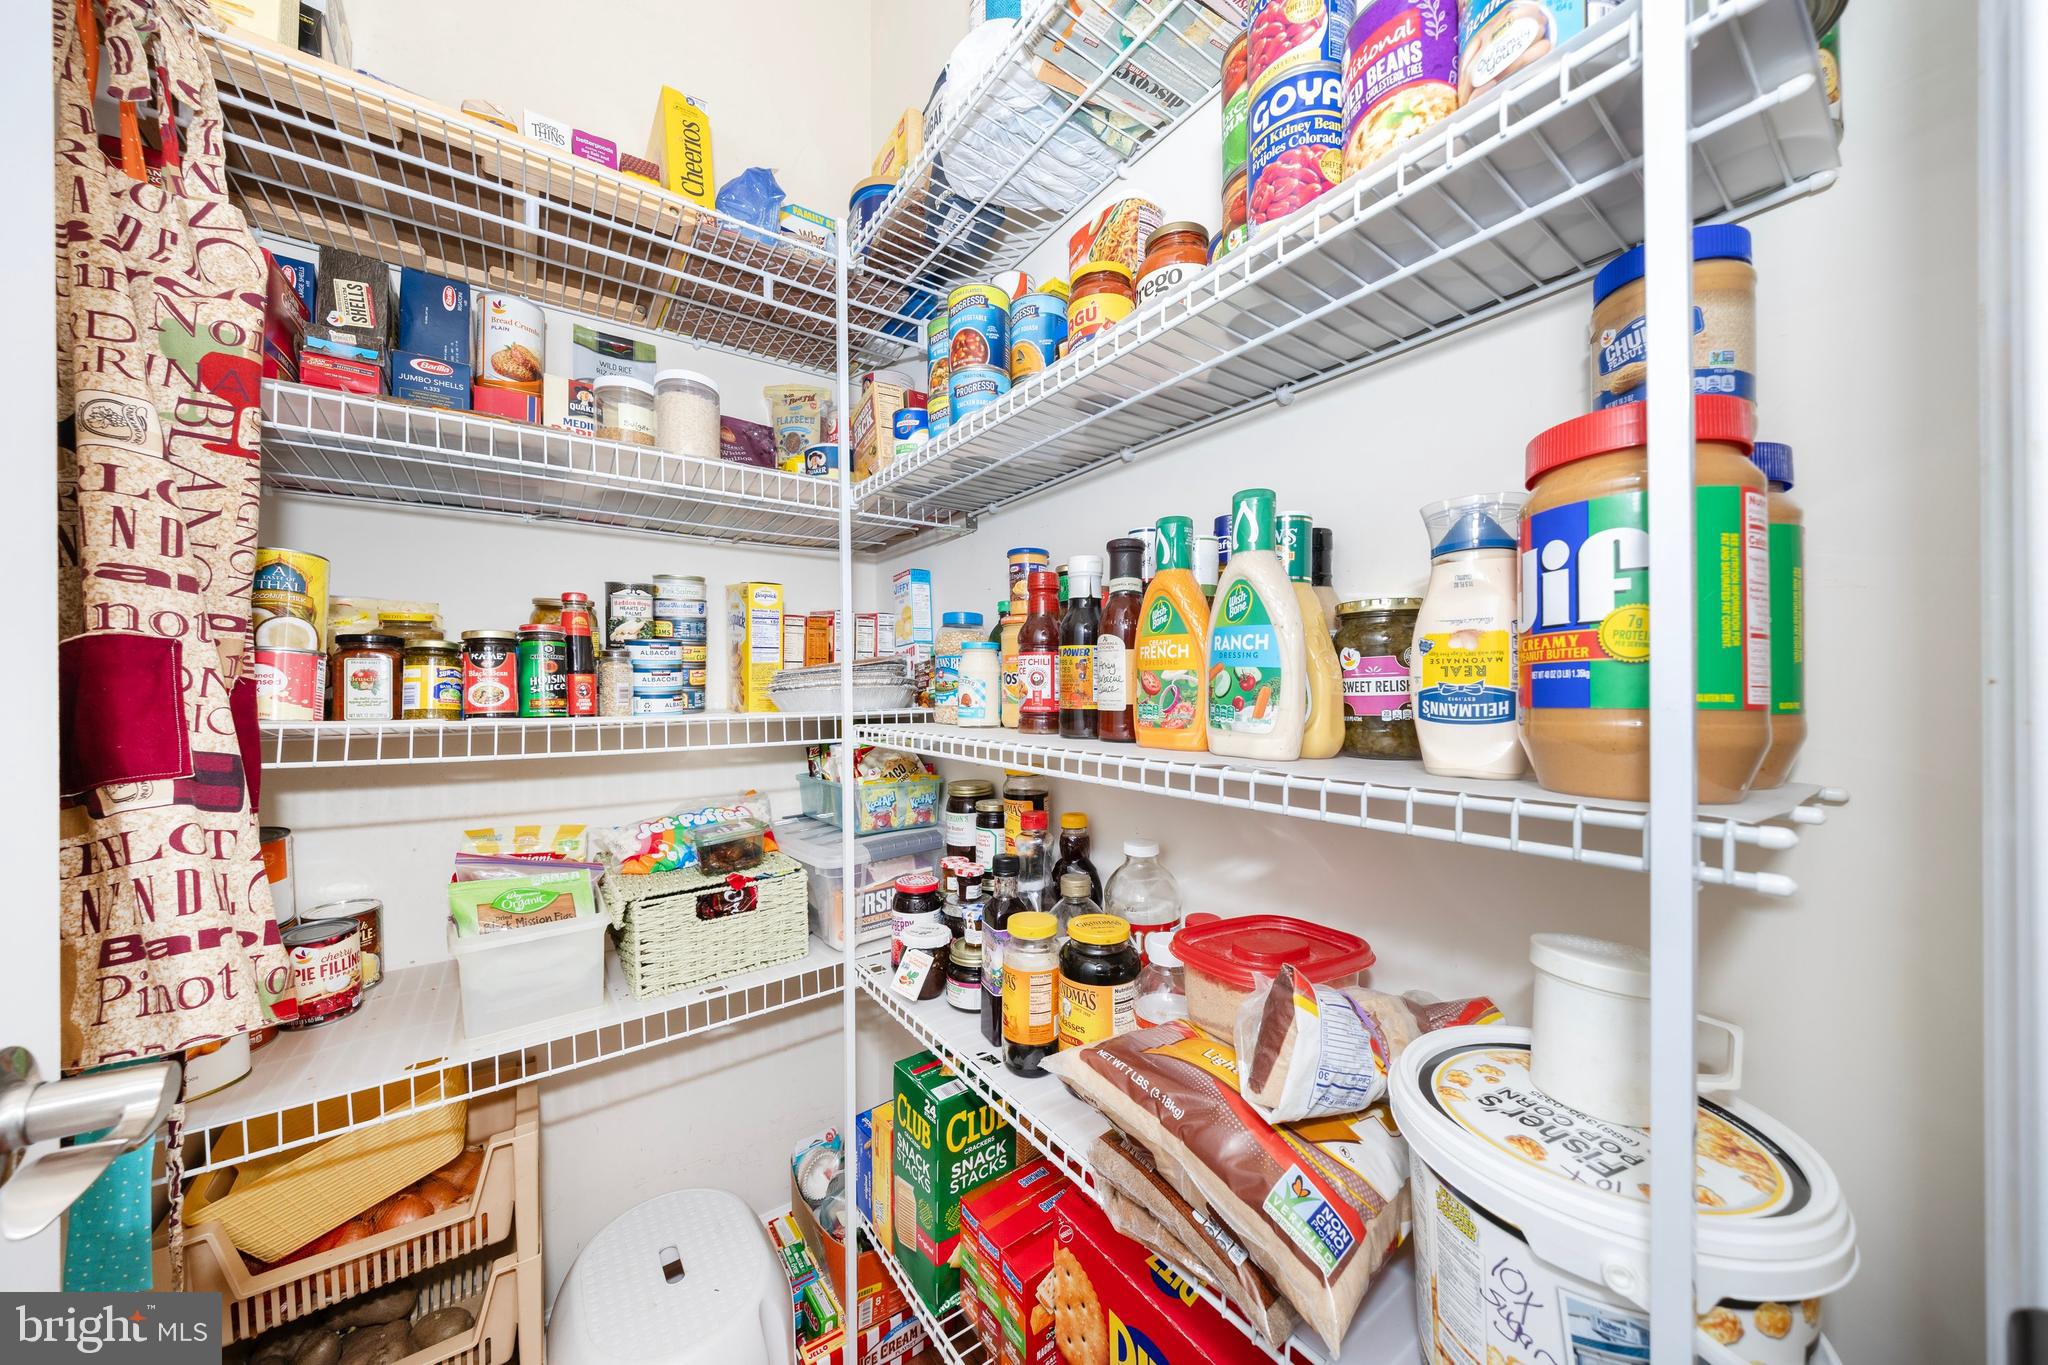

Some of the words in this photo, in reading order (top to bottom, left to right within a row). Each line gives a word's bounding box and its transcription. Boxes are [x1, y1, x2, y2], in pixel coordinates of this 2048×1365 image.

[1365, 40, 1424, 86] BEANS
[1366, 69, 1406, 105] CHOLESTEROL
[1407, 62, 1423, 78] FREE
[1253, 77, 1342, 133] GOYA
[531, 122, 566, 147] THINS
[1252, 141, 1268, 160] Red
[1270, 118, 1311, 143] Kidney
[681, 119, 705, 198] Cheerios
[1252, 142, 1287, 175] Frijoles
[1136, 268, 1183, 307] rego
[347, 283, 368, 324] SHELLS
[950, 295, 986, 317] PROGRESSO
[491, 316, 513, 326] Bread
[1604, 327, 1646, 363] CHU
[419, 359, 450, 374] Barilla
[600, 360, 617, 371] WILD
[618, 363, 633, 374] RICE
[398, 372, 432, 384] JUMBO
[433, 378, 465, 391] SHELLS
[955, 381, 996, 398] PROGRESSO
[855, 416, 874, 444] JACK
[272, 565, 286, 577] A
[1518, 527, 1649, 633] Jif
[257, 579, 303, 592] THAI
[1628, 614, 1643, 630] 7g
[1214, 633, 1270, 651] RANCH
[1522, 634, 1579, 652] CREAMY
[1613, 630, 1649, 640] PROTEI
[1027, 658, 1050, 666] CHILI
[1062, 647, 1091, 657] POWER
[1140, 644, 1190, 659] FRENCH
[1218, 651, 1259, 660] DRESSING
[1430, 656, 1504, 664] MAYONNAISE
[1546, 646, 1589, 660] BUTTER
[1439, 665, 1487, 677] REAL
[1343, 681, 1371, 693] SWEET
[1422, 699, 1510, 719] HELLMANN'S
[867, 791, 896, 812] Kool-Aid
[910, 792, 937, 810] Kool-Aid
[501, 894, 547, 911] Organic
[516, 915, 553, 928] Mission
[321, 948, 353, 964] cherry
[294, 966, 316, 982] PIE
[1096, 1048, 1115, 1065] NET
[1113, 1058, 1128, 1074] WT
[1125, 1066, 1133, 1077] 7
[1131, 1072, 1150, 1093] LBS.
[1150, 1086, 1185, 1121] (3.18kg)
[923, 1098, 937, 1117] 24
[1497, 1086, 1575, 1128] CORN
[897, 1093, 931, 1150] CLUB
[963, 1135, 995, 1154] CRACKERS
[1477, 1094, 1629, 1180] Fisher's
[1577, 1128, 1646, 1167] POP
[897, 1132, 931, 1179] SNACK
[951, 1138, 1007, 1179] SNACK
[896, 1146, 931, 1194] STACKS
[950, 1155, 1008, 1195] STACKS
[1273, 1195, 1333, 1264] VERIFIED
[1315, 1213, 1345, 1251] GMO
[1321, 1207, 1351, 1244] NON
[1310, 1219, 1340, 1256] Project
[881, 1330, 919, 1358] CREAM
